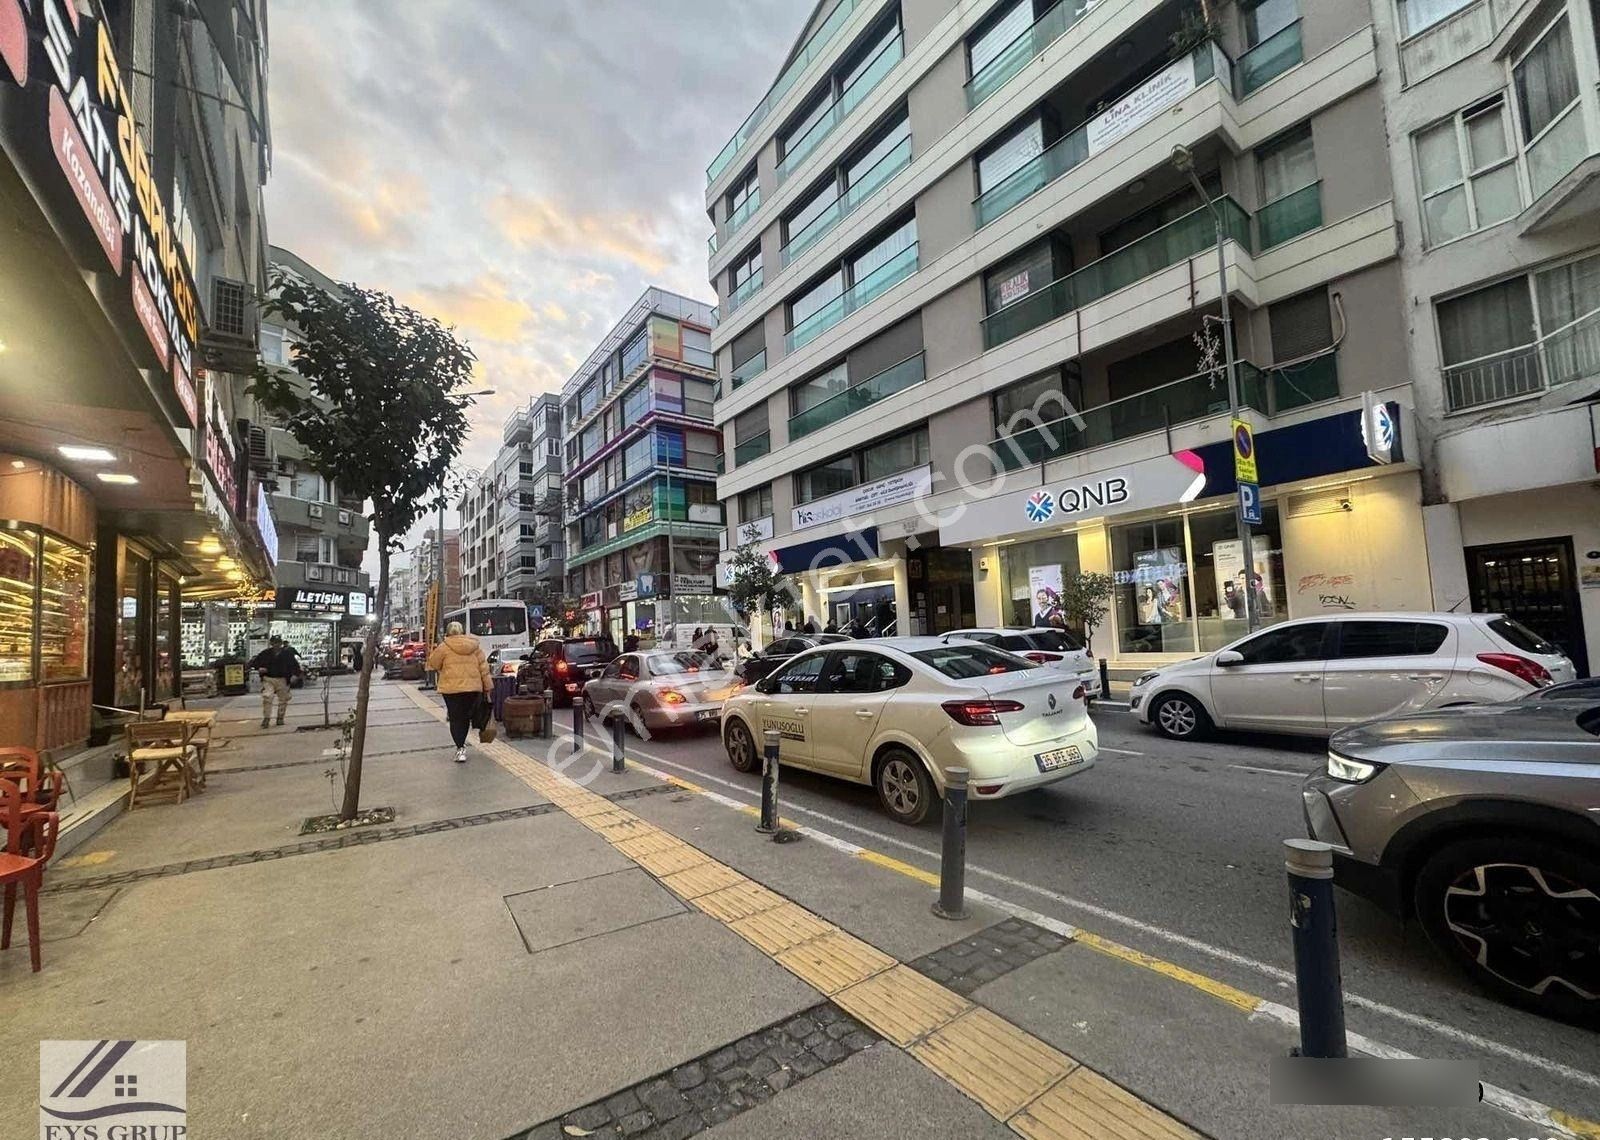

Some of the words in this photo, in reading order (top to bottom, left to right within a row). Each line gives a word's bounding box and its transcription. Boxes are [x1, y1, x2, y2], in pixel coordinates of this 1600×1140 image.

[61, 127, 117, 253] Kazandibi
[1058, 478, 1128, 513] QNB
[295, 590, 344, 605] İLETİŞİM
